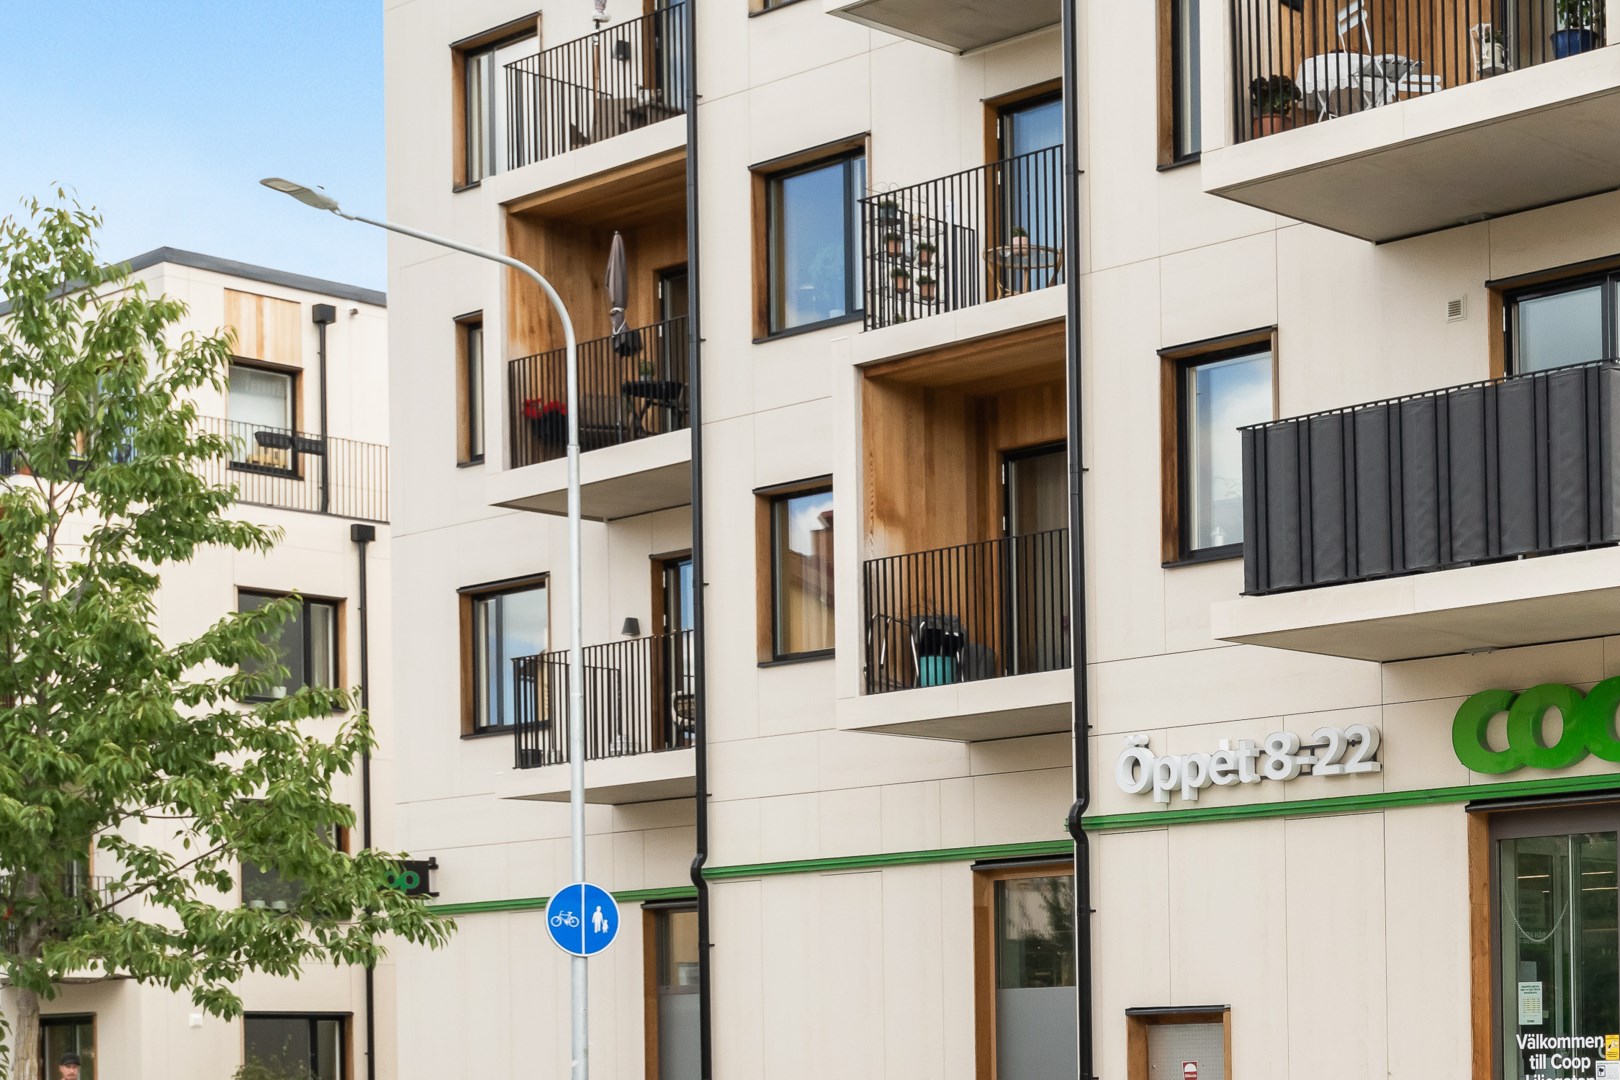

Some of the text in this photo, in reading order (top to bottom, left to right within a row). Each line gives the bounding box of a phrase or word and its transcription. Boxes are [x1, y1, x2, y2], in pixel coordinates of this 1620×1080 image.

[1115, 723, 1381, 803] Öppet 8-22
[1516, 1033, 1604, 1050] Välkommen
[1529, 1053, 1591, 1073] till Coop
